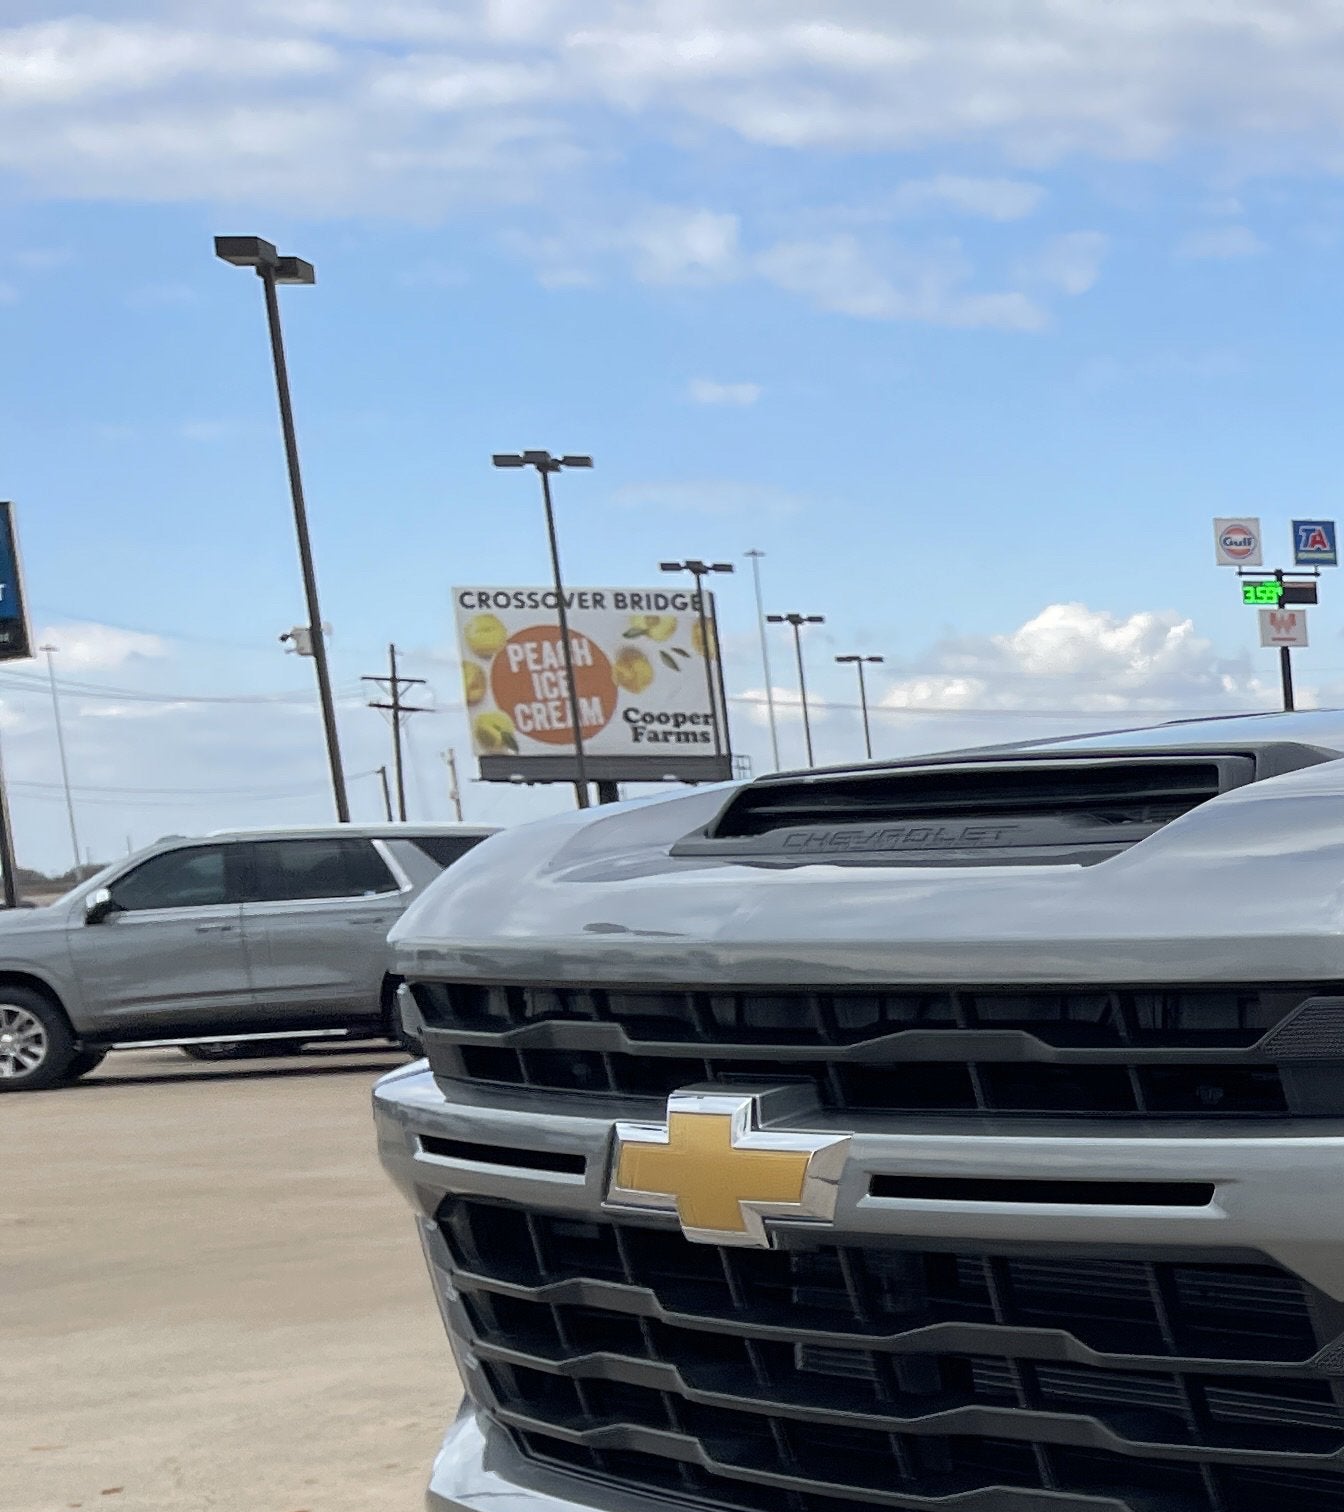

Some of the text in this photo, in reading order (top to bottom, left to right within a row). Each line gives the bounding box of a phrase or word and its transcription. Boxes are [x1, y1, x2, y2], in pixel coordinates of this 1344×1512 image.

[1222, 536, 1254, 547] Gulf
[1299, 526, 1330, 550] TA
[458, 591, 703, 611] CROSSOVER BRIDGE
[531, 670, 571, 701] ICE
[622, 707, 715, 728] Cooper
[631, 725, 711, 743] Farms
[782, 825, 1020, 849] CHEVROLET
